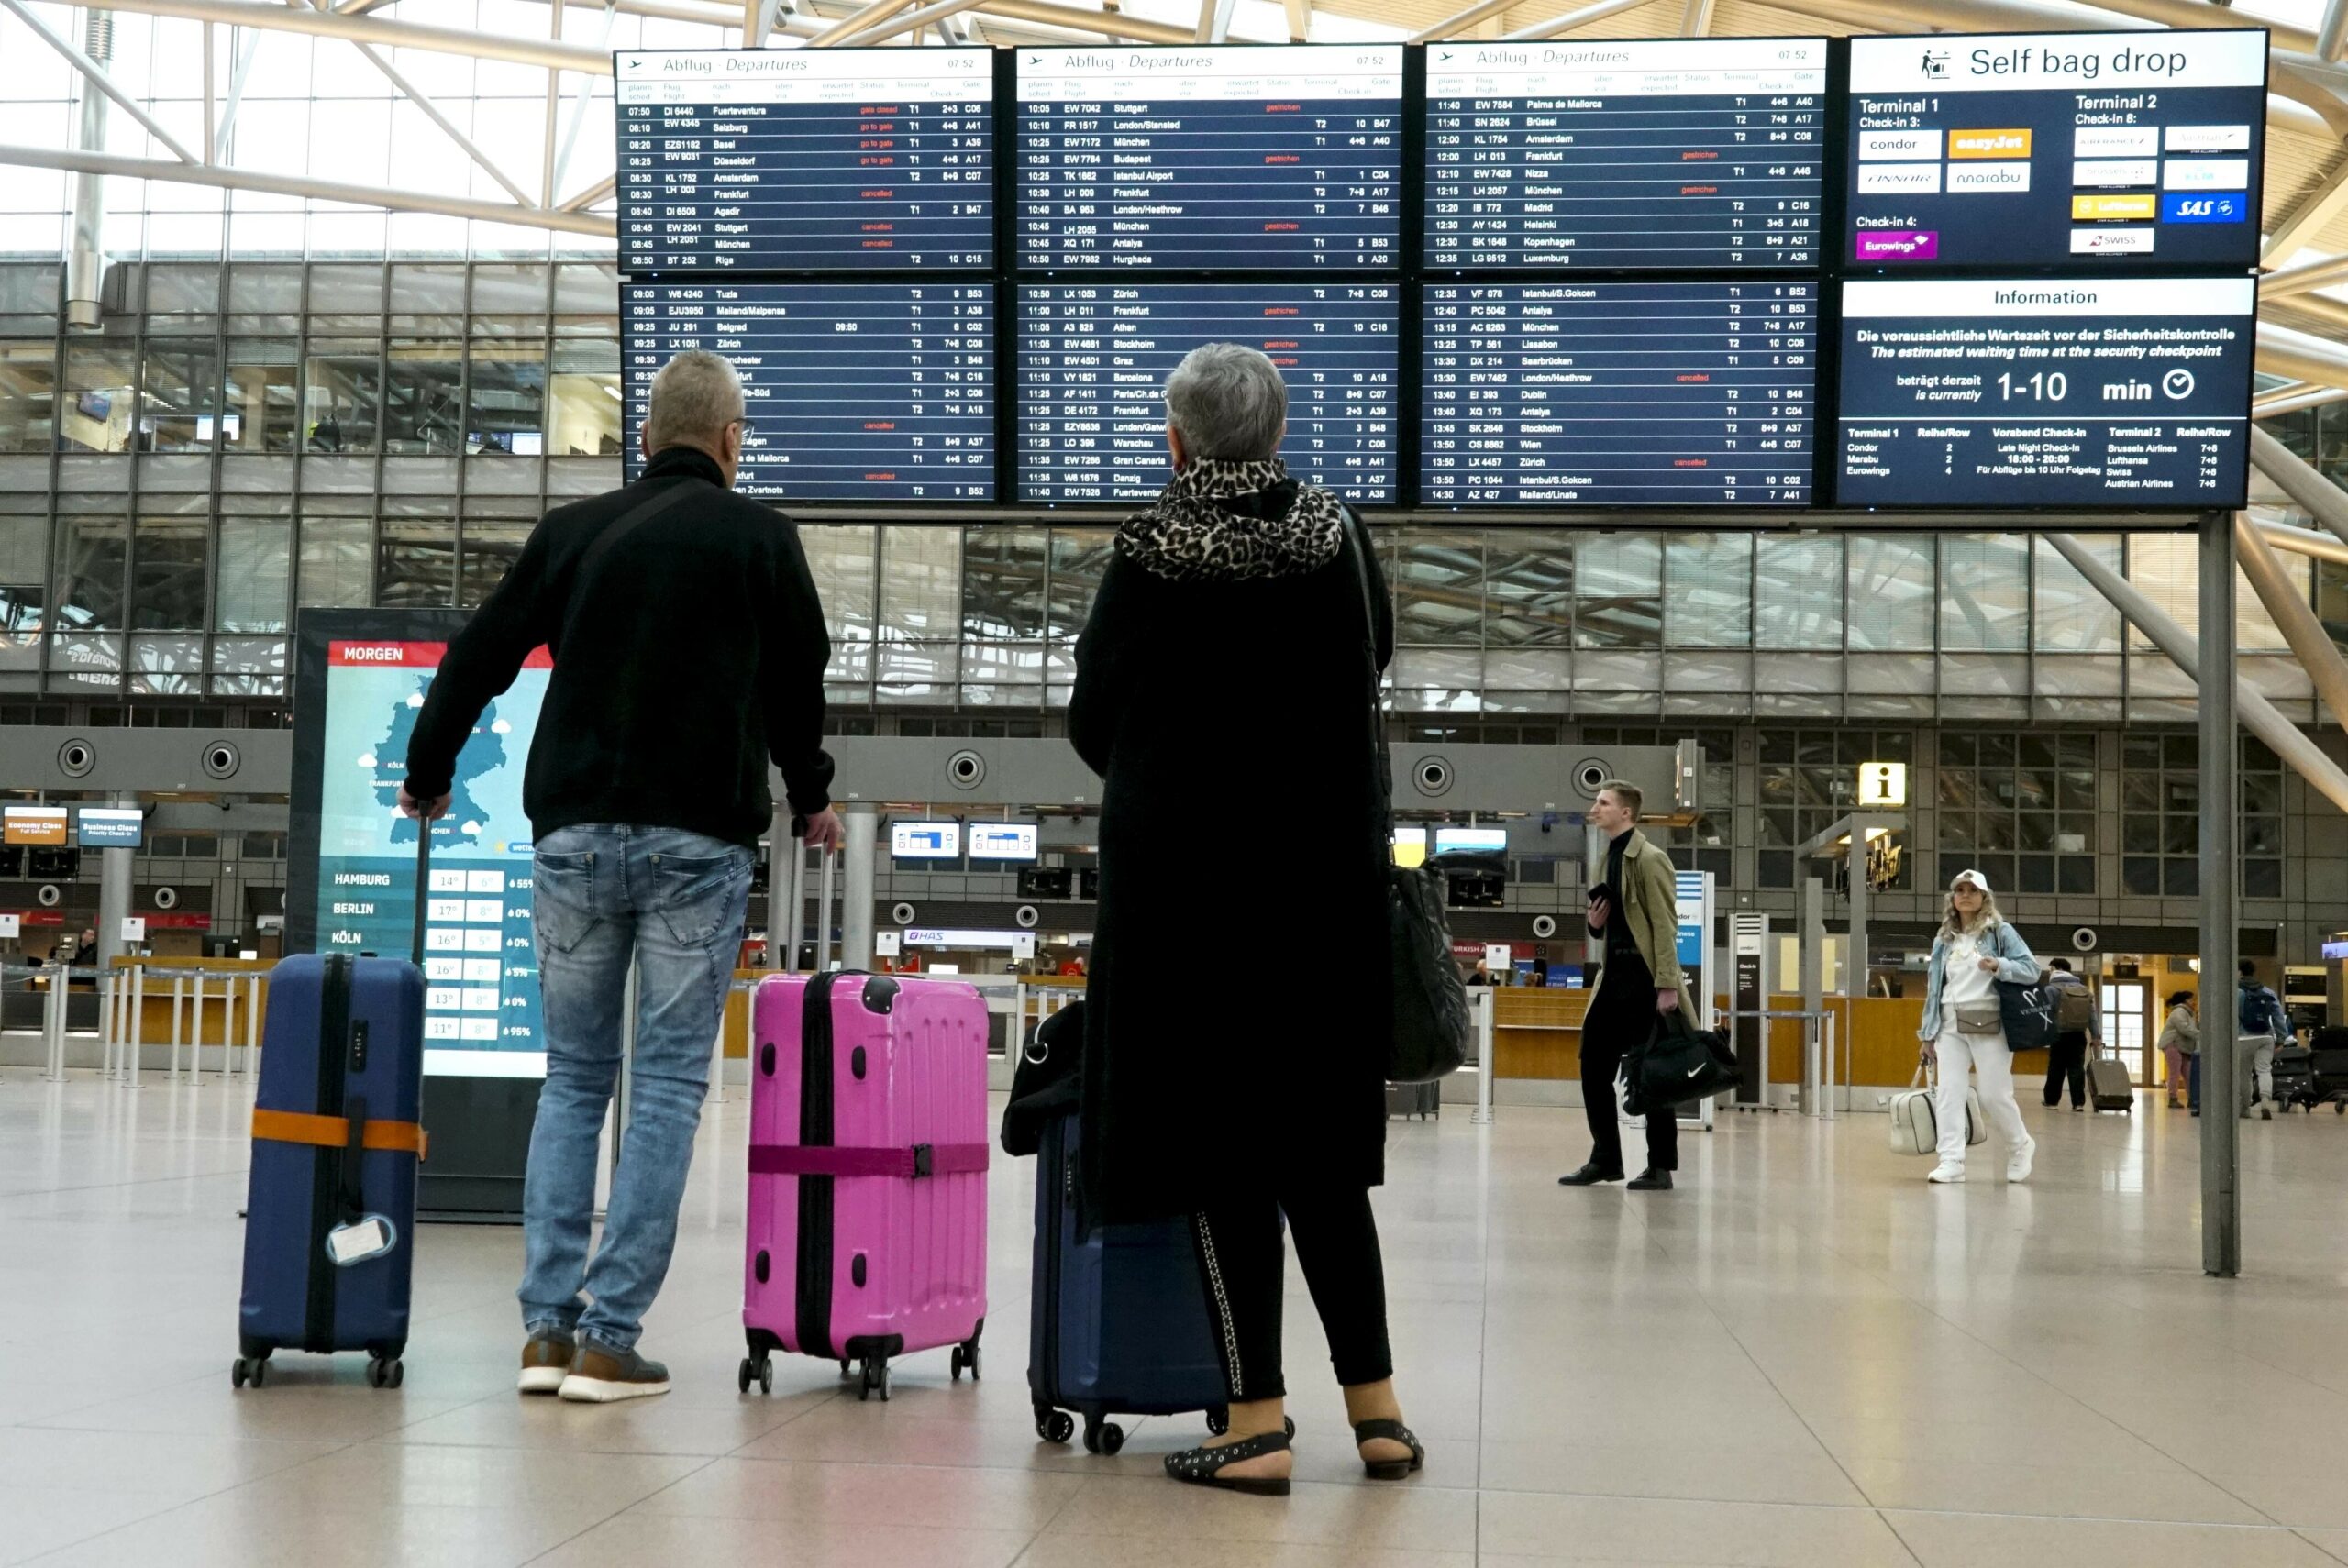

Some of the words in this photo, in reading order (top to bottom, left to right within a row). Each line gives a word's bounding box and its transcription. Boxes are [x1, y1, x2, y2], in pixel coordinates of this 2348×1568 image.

[1066, 55, 1113, 70] Abflug
[1130, 55, 1212, 70] Departures
[1477, 51, 1526, 65] Abflug
[1544, 50, 1629, 65] Departures
[1971, 49, 2032, 74] Self
[2043, 49, 2099, 79] bag
[2113, 47, 2186, 77] drop
[664, 59, 711, 73] Abflug
[726, 59, 806, 72] Departures
[1860, 98, 1926, 113] Terminal
[1933, 99, 1939, 112] 1
[2076, 95, 2143, 109] Terminal
[2148, 95, 2156, 108] 2
[629, 107, 650, 116] 07:50
[713, 106, 766, 116] Fuerteventura
[1860, 117, 1907, 127] Check-in
[1910, 116, 1920, 127] 3:
[2076, 114, 2123, 124] Check-in
[2127, 113, 2137, 124] 8:
[714, 124, 748, 133] Salzburg
[1029, 121, 1049, 129] 10:10
[1113, 120, 1180, 131] London/Stansted
[1870, 138, 1917, 149] condor
[714, 157, 756, 167] Düsseldorf
[714, 173, 759, 183] Amsterdam
[1028, 171, 1049, 180] 10:25
[1113, 171, 1144, 182] Istanbul
[1146, 171, 1173, 182] Airport
[1437, 170, 1459, 178] 12:10
[1525, 169, 1548, 180] Nizza
[1957, 171, 2021, 184] marabu
[714, 207, 740, 216] Agadir
[2176, 201, 2214, 215] SAS
[1028, 222, 1049, 230] 10:45
[1113, 221, 1149, 232] München
[1856, 216, 1903, 226] Check-in
[1907, 216, 1916, 226] 4:
[1436, 237, 1457, 246] 12:30
[1524, 237, 1575, 248] Kopenhagen
[2104, 236, 2136, 245] SWISS
[1866, 240, 1916, 253] Eurowings
[634, 291, 655, 299] 09:00
[716, 290, 737, 301] Tuzla
[1996, 290, 2097, 304] Information
[717, 306, 785, 316] Mailand/Malpensa
[1113, 323, 1136, 333] Athen
[1857, 330, 1879, 341] Die
[1882, 330, 1986, 341] voraussichtliche
[1988, 329, 2050, 341] Wartezeit
[2054, 330, 2075, 341] vor
[2078, 329, 2100, 340] der
[2103, 328, 2235, 340] Sicherheitskontrolle
[717, 338, 741, 349] Zürich
[1434, 340, 1456, 348] 13:25
[1522, 339, 1558, 350] Lissabon
[1872, 346, 1895, 358] The
[1898, 346, 1964, 357] estimated
[1966, 346, 2016, 359] waiting
[2019, 346, 2049, 357] time
[2052, 347, 2066, 358] at
[2069, 346, 2091, 357] the
[2094, 345, 2146, 359] security
[2149, 345, 2222, 359] checkpoint
[1029, 373, 1050, 381] 11:10
[1113, 372, 1153, 383] Barcelona
[1897, 375, 1939, 388] beträgt
[1942, 375, 1981, 385] derzeit
[1998, 372, 2066, 401] 1-10
[2103, 379, 2152, 400] min
[1434, 391, 1456, 399] 13:40
[1521, 390, 1546, 401] Dublin
[1916, 390, 1926, 400] is
[1929, 390, 1981, 402] currently
[1848, 428, 1890, 437] Terminal
[1893, 429, 1899, 437] 1
[1918, 428, 1970, 437] Reihe/Row
[1993, 428, 2040, 437] Vorabend
[2043, 428, 2086, 437] Check-in
[2109, 427, 2153, 436] Terminal
[2154, 427, 2161, 437] 2
[2177, 427, 2231, 436] Reihe/Row
[1847, 444, 1878, 452] Condor
[1946, 444, 1952, 452] 2
[1998, 444, 2016, 452] Late
[2018, 444, 2040, 454] Night
[2043, 444, 2079, 452] Check-in
[2108, 444, 2144, 453] Brussels
[1847, 455, 1878, 463] Marabu
[1946, 455, 1952, 463] 2
[2107, 456, 2148, 465] Lufthansa
[1847, 467, 1890, 476] Eurowings
[1945, 467, 1952, 475] 4
[1977, 466, 1991, 475] Für
[1992, 466, 2022, 475] Abflüge
[2024, 466, 2035, 475] bis
[2038, 466, 2047, 475] 10
[2050, 466, 2065, 475] Uhr
[2066, 466, 2101, 475] Folgetag
[2107, 468, 2132, 476] Swiss
[2105, 479, 2141, 489] Austrian
[2143, 479, 2174, 489] Airlines
[345, 647, 403, 660] MORGEN
[335, 874, 390, 885] HAMBURG
[334, 903, 373, 914] BERLIN
[515, 909, 530, 918] 0%
[332, 930, 361, 944] KÖLN
[919, 932, 945, 941] HAS
[514, 938, 529, 947] 0%
[512, 998, 526, 1006] 0%
[511, 1027, 530, 1036] 95%
